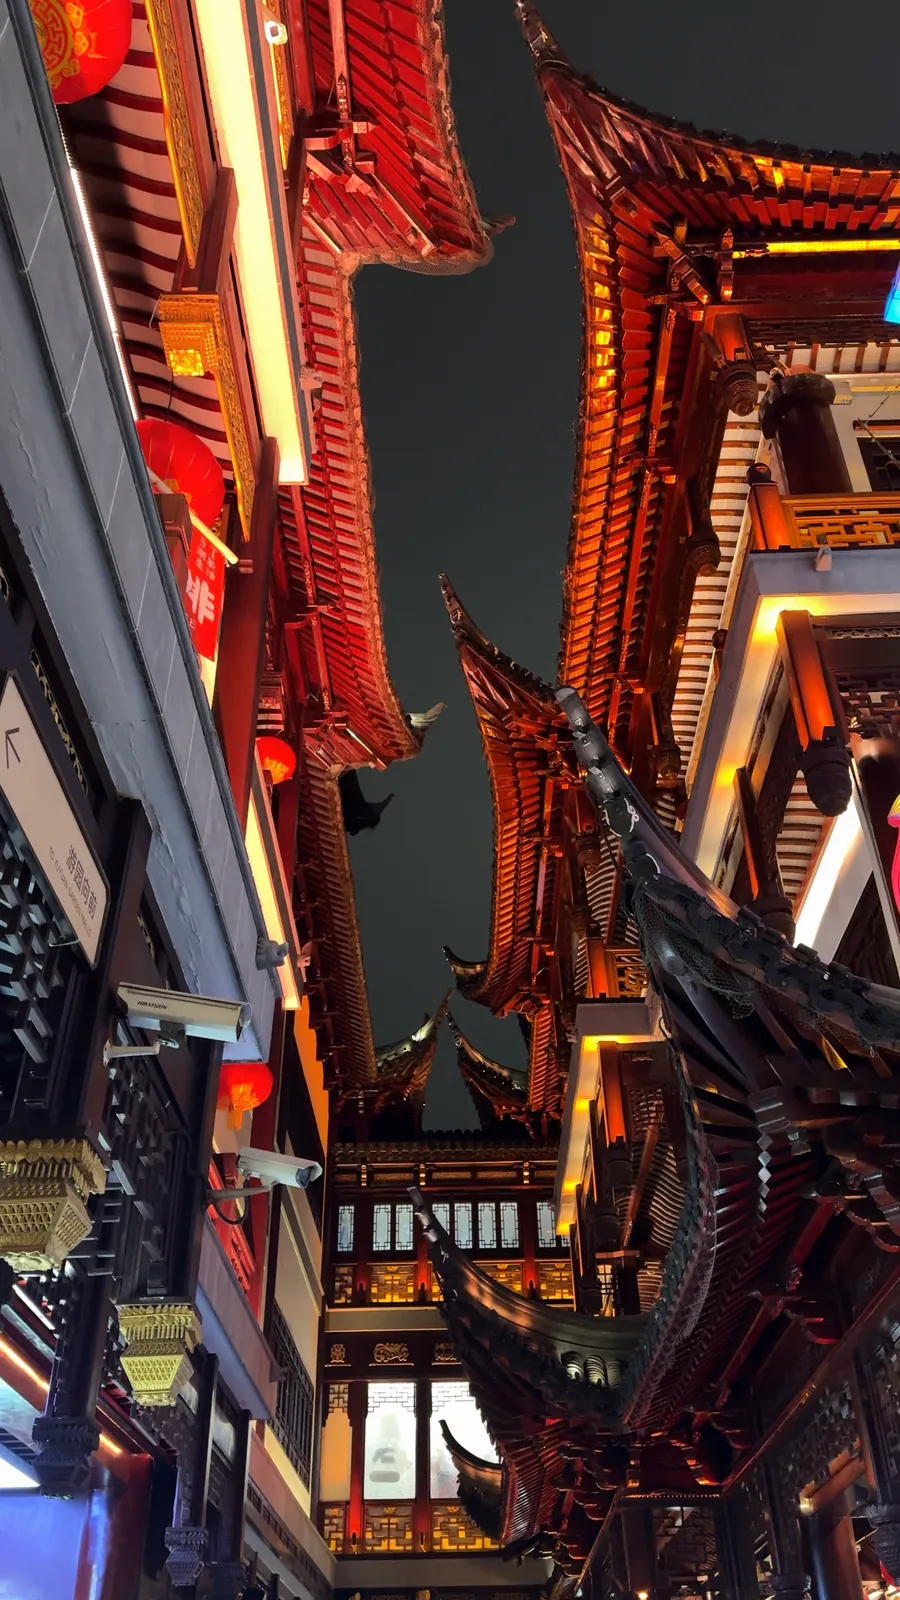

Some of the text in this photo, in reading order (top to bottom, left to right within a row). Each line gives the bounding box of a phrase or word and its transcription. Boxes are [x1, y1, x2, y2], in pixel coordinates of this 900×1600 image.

[48, 845, 54, 860] TO
[66, 844, 97, 919] 游园向前
[137, 1000, 168, 1010] HIKVISION
